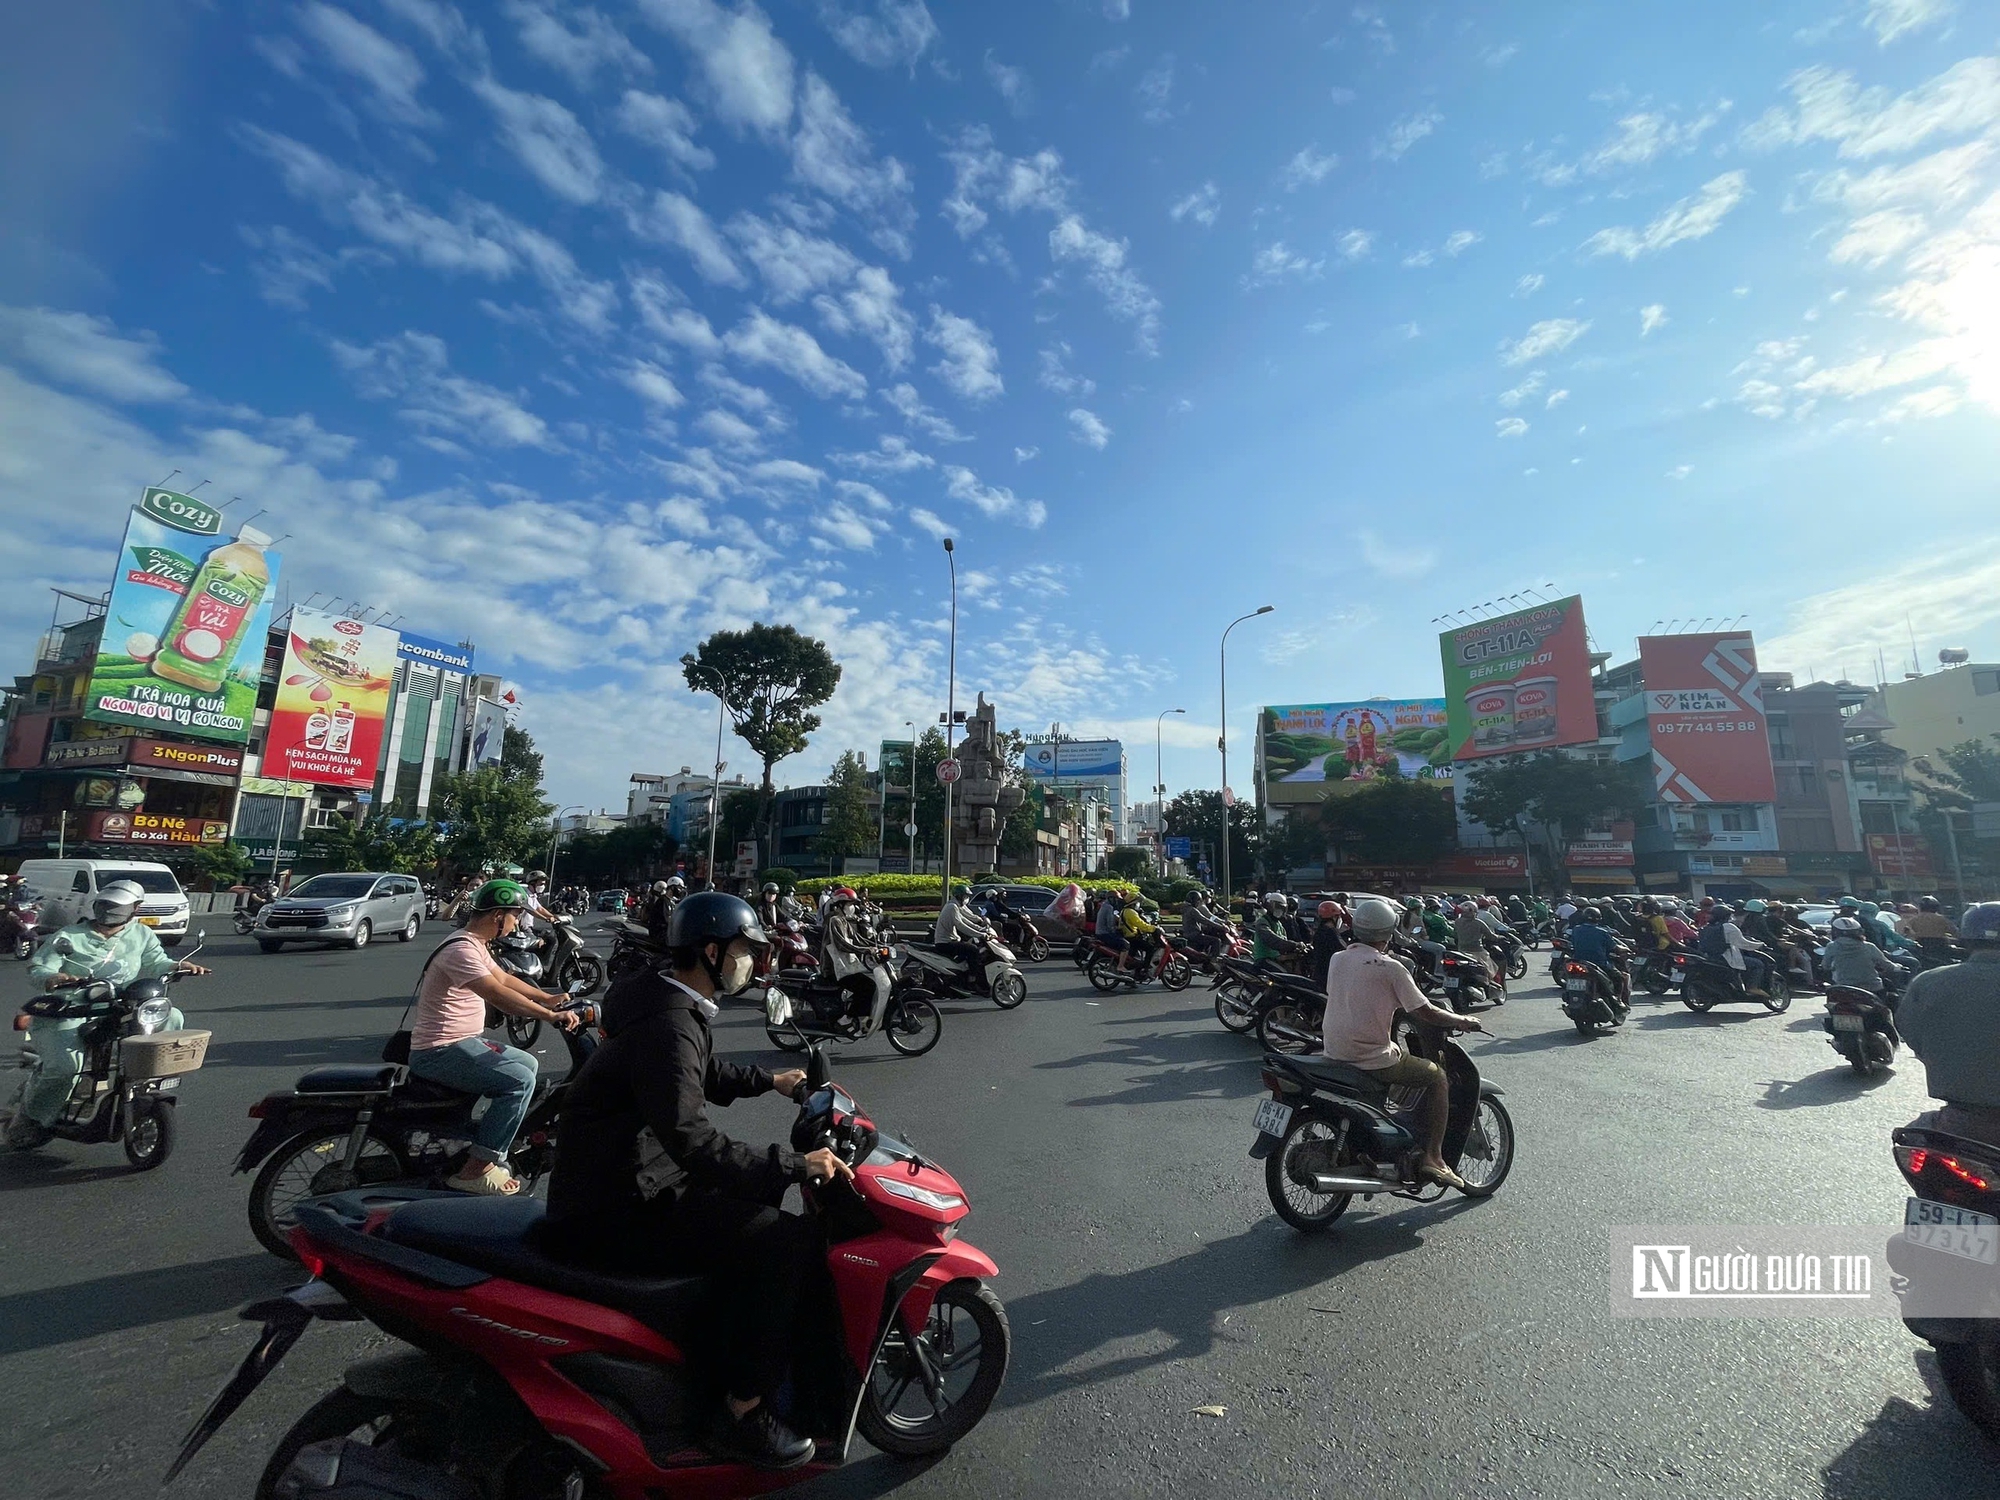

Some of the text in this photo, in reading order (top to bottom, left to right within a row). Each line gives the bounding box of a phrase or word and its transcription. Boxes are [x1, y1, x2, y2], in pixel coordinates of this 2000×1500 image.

[153, 493, 213, 528] Cozy
[146, 559, 192, 583] Mới
[209, 581, 245, 605] Cozy
[214, 604, 230, 614] Trà
[1525, 606, 1560, 624] KOVA
[1533, 623, 1552, 634] PLUS
[1463, 628, 1536, 661] CT-11A
[133, 685, 226, 713] TRÀ HOA QUẢ
[1520, 692, 1544, 703] KOVA
[1679, 692, 1709, 701] KIM
[1480, 700, 1502, 710] KOVA
[1680, 701, 1727, 710] NGAN
[100, 697, 243, 730] NGON RÕ VỊ VỊ RÕ NGON
[1479, 716, 1506, 726] CT-11A
[1657, 721, 1756, 733] 09 77 44 55 88
[286, 748, 362, 766] HẸN SẠCH MÙA HẠ
[291, 761, 306, 769] VUI
[332, 765, 343, 774] CẢ
[344, 767, 355, 776] HÈ
[162, 817, 187, 829] Né
[170, 831, 201, 842] Hàu
[842, 1252, 880, 1267] HONDA
